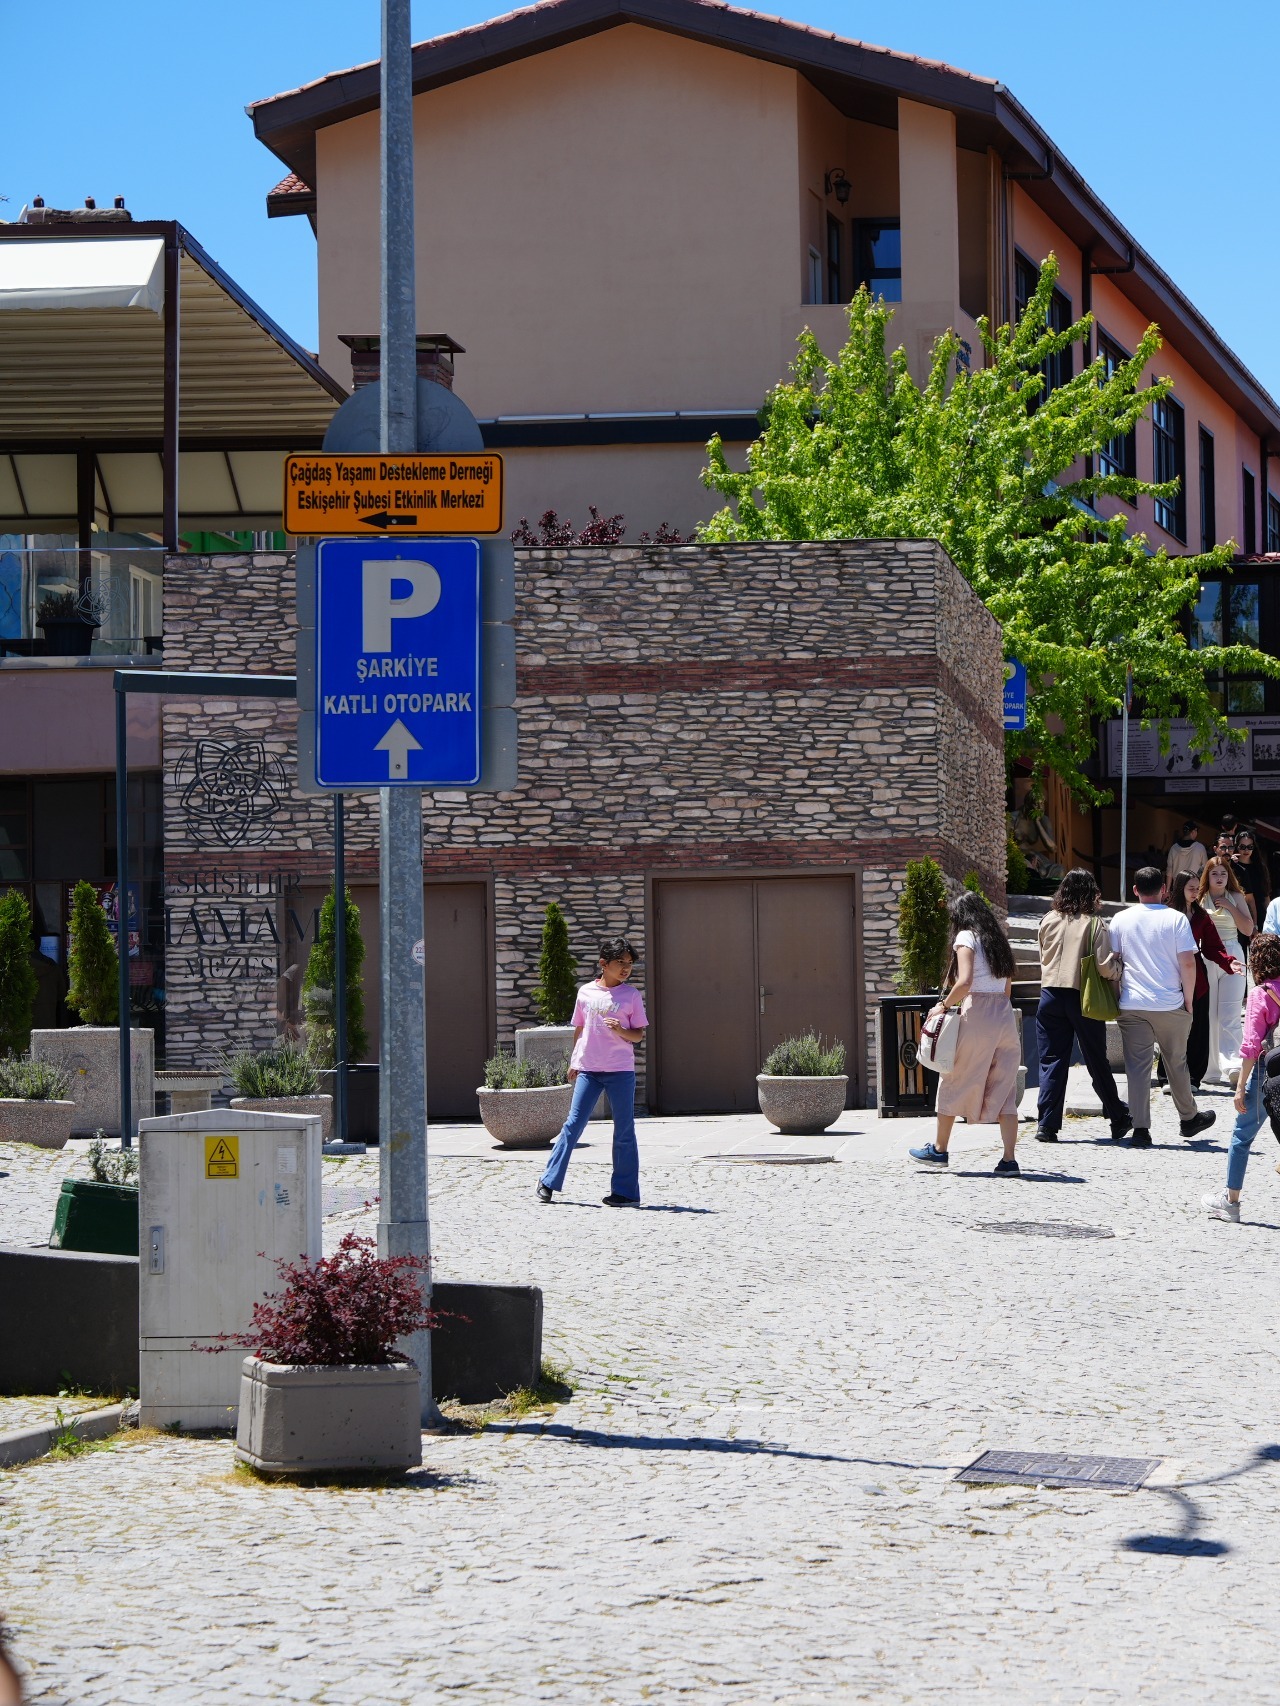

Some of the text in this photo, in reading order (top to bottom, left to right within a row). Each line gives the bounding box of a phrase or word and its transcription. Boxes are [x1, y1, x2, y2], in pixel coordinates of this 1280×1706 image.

[290, 461, 493, 486] Çağdaş Yaşamı Destekleme Derneği
[298, 489, 485, 514] Eskişehir Şubesi Etkinlik Merkezi
[362, 560, 441, 653] P
[356, 653, 439, 683] ŞARKİYE
[324, 692, 472, 715] KATLI OTOPARK
[140, 907, 322, 945] HAMAM
